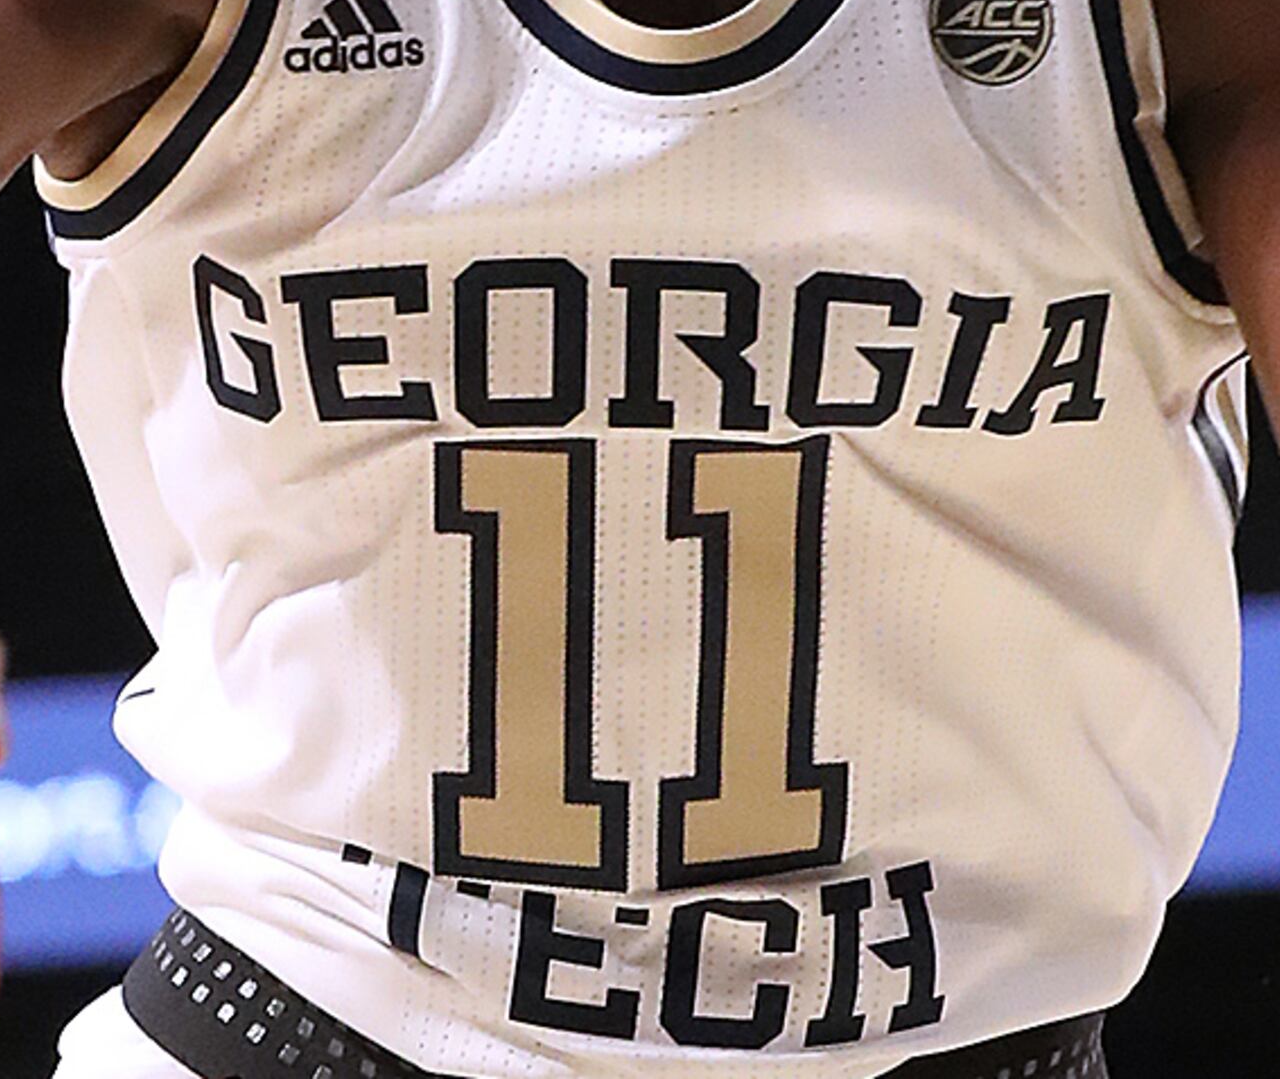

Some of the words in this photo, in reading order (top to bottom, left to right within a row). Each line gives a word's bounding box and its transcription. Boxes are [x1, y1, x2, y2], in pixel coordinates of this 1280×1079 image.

[284, 34, 424, 73] adidas
[944, 0, 1046, 28] ACC
[193, 255, 1111, 433] GEORGIA
[433, 434, 849, 892] 11
